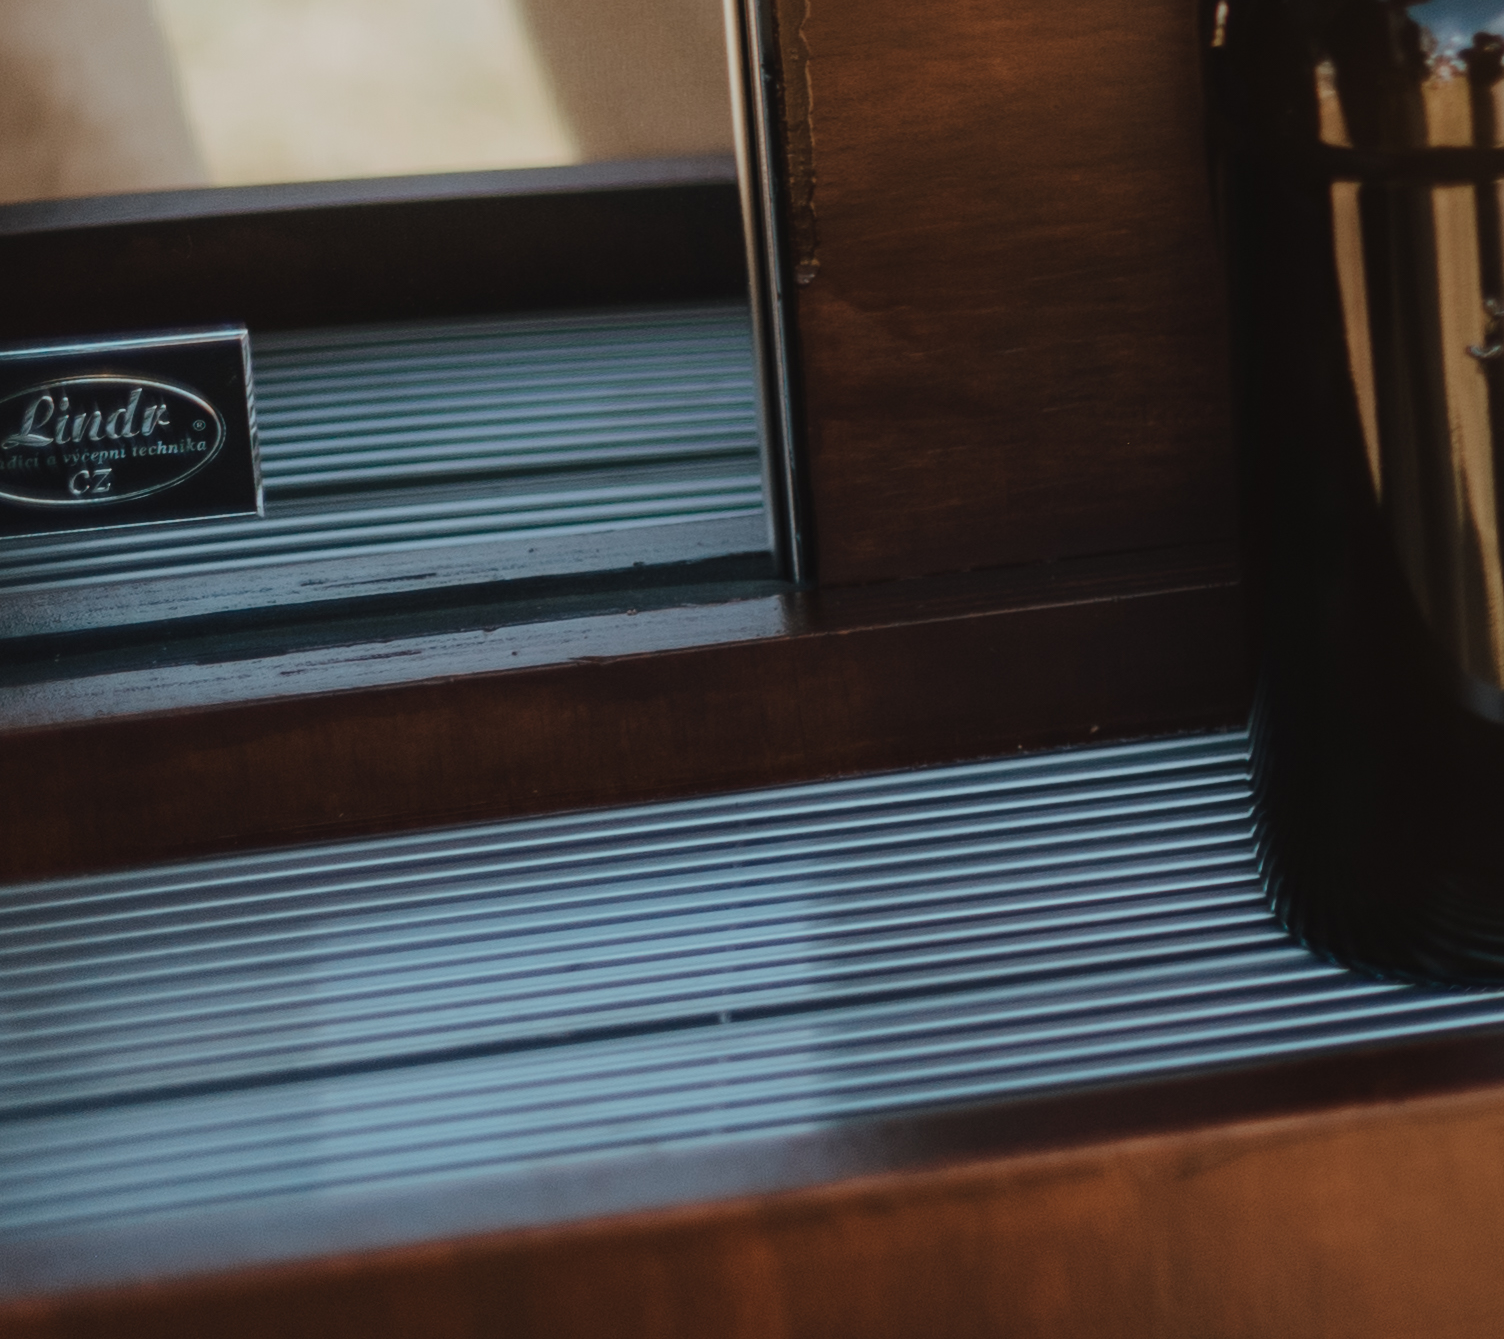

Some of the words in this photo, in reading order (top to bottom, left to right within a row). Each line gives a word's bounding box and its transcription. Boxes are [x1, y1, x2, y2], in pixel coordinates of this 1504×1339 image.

[1, 387, 171, 450] Lindr
[132, 437, 207, 458] technika
[68, 467, 113, 496] CZ
